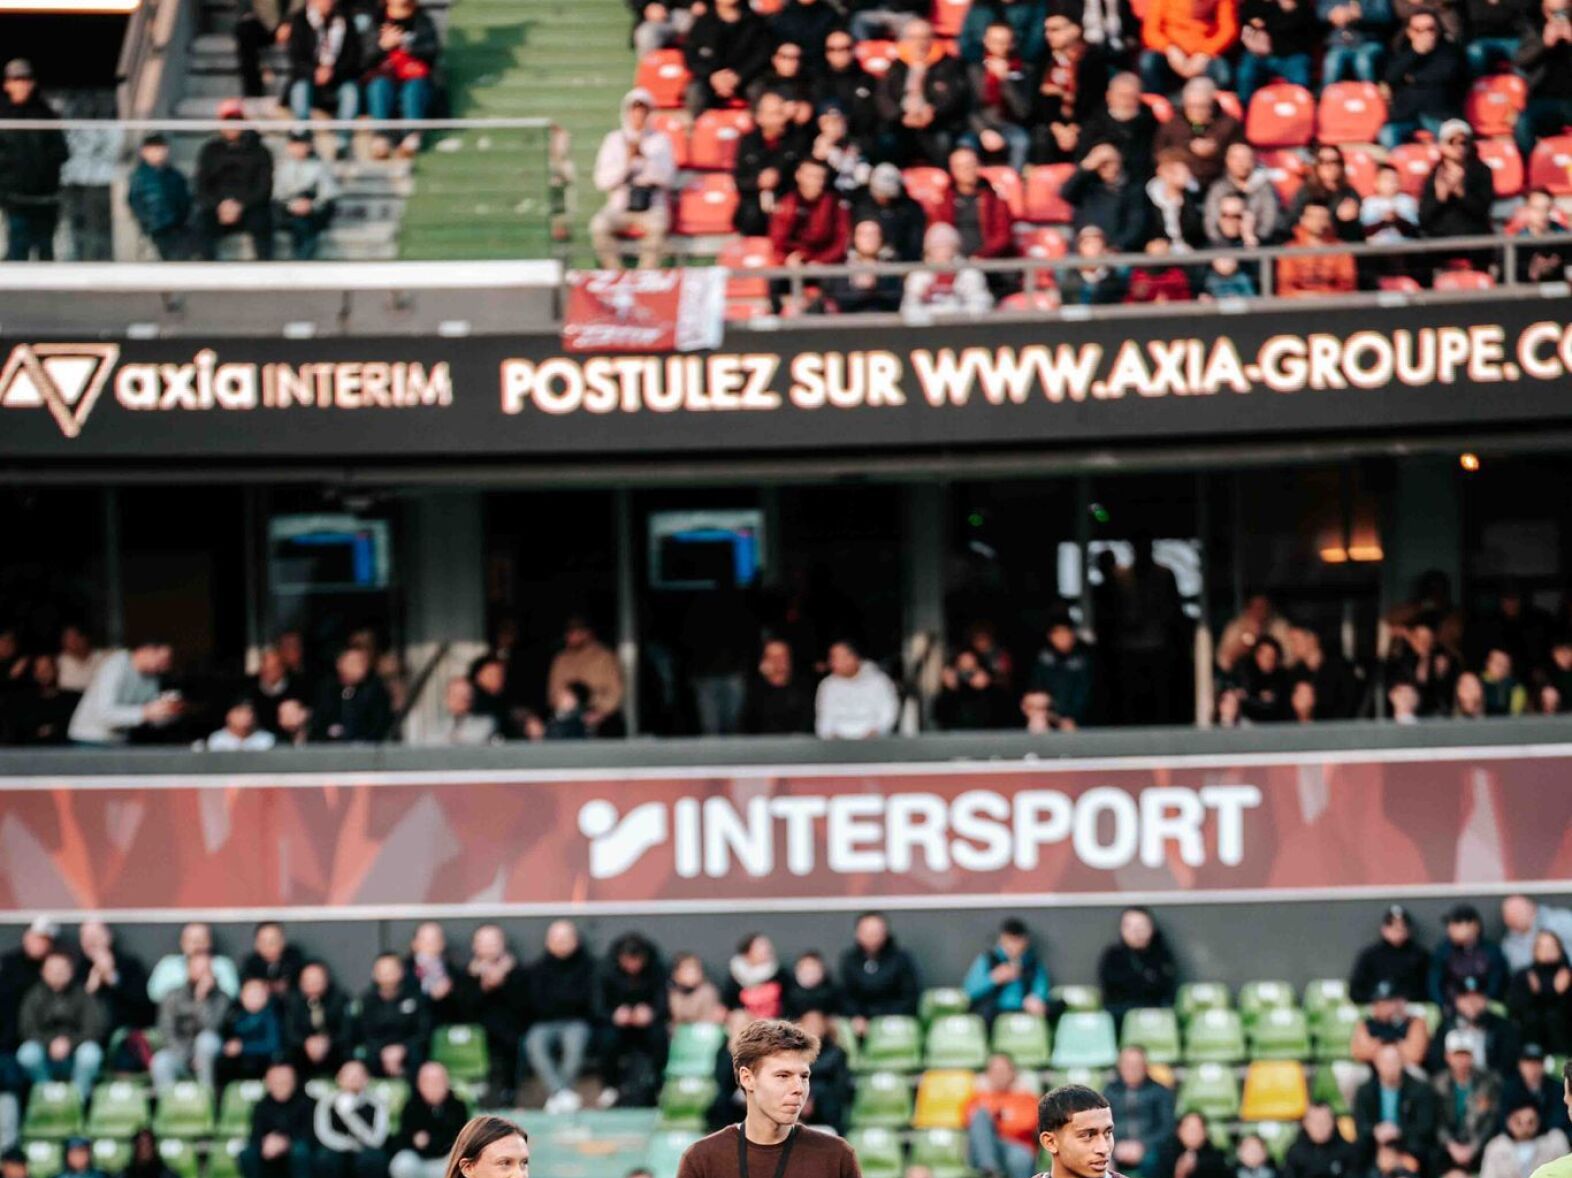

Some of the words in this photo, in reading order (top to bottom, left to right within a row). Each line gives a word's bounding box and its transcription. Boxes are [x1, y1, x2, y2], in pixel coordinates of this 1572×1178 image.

[116, 348, 258, 410] axia
[262, 361, 454, 409] INTERIM
[501, 354, 781, 415] POSTULEZ
[791, 352, 907, 408] SUR
[911, 320, 1572, 407] WWW.AXIA-GROUPE.C
[674, 784, 1262, 880] INTERSPORT
